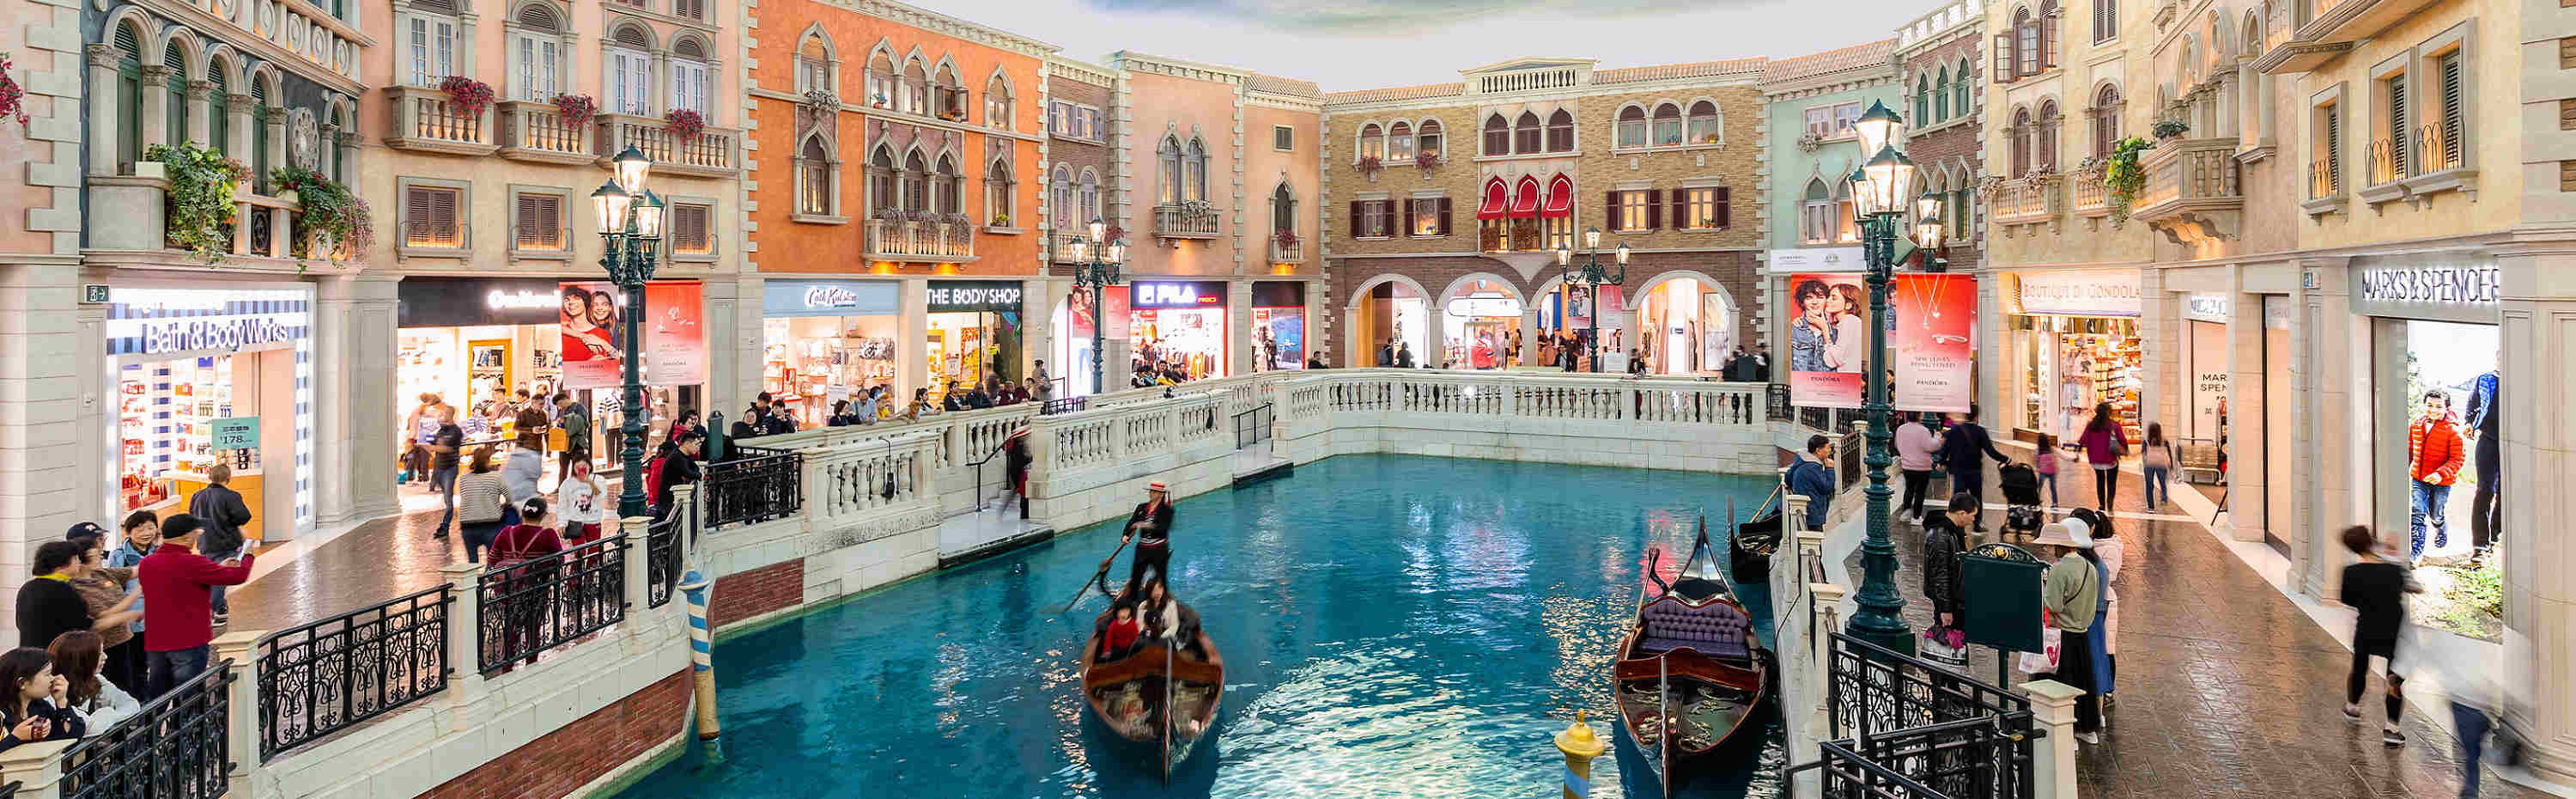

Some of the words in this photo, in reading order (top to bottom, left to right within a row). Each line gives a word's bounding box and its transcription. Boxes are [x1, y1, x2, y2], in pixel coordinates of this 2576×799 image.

[927, 288, 950, 304] THE
[952, 288, 987, 304] BODY
[2362, 269, 2407, 300] MARKS
[2409, 270, 2420, 300] &
[147, 321, 190, 354] Bath
